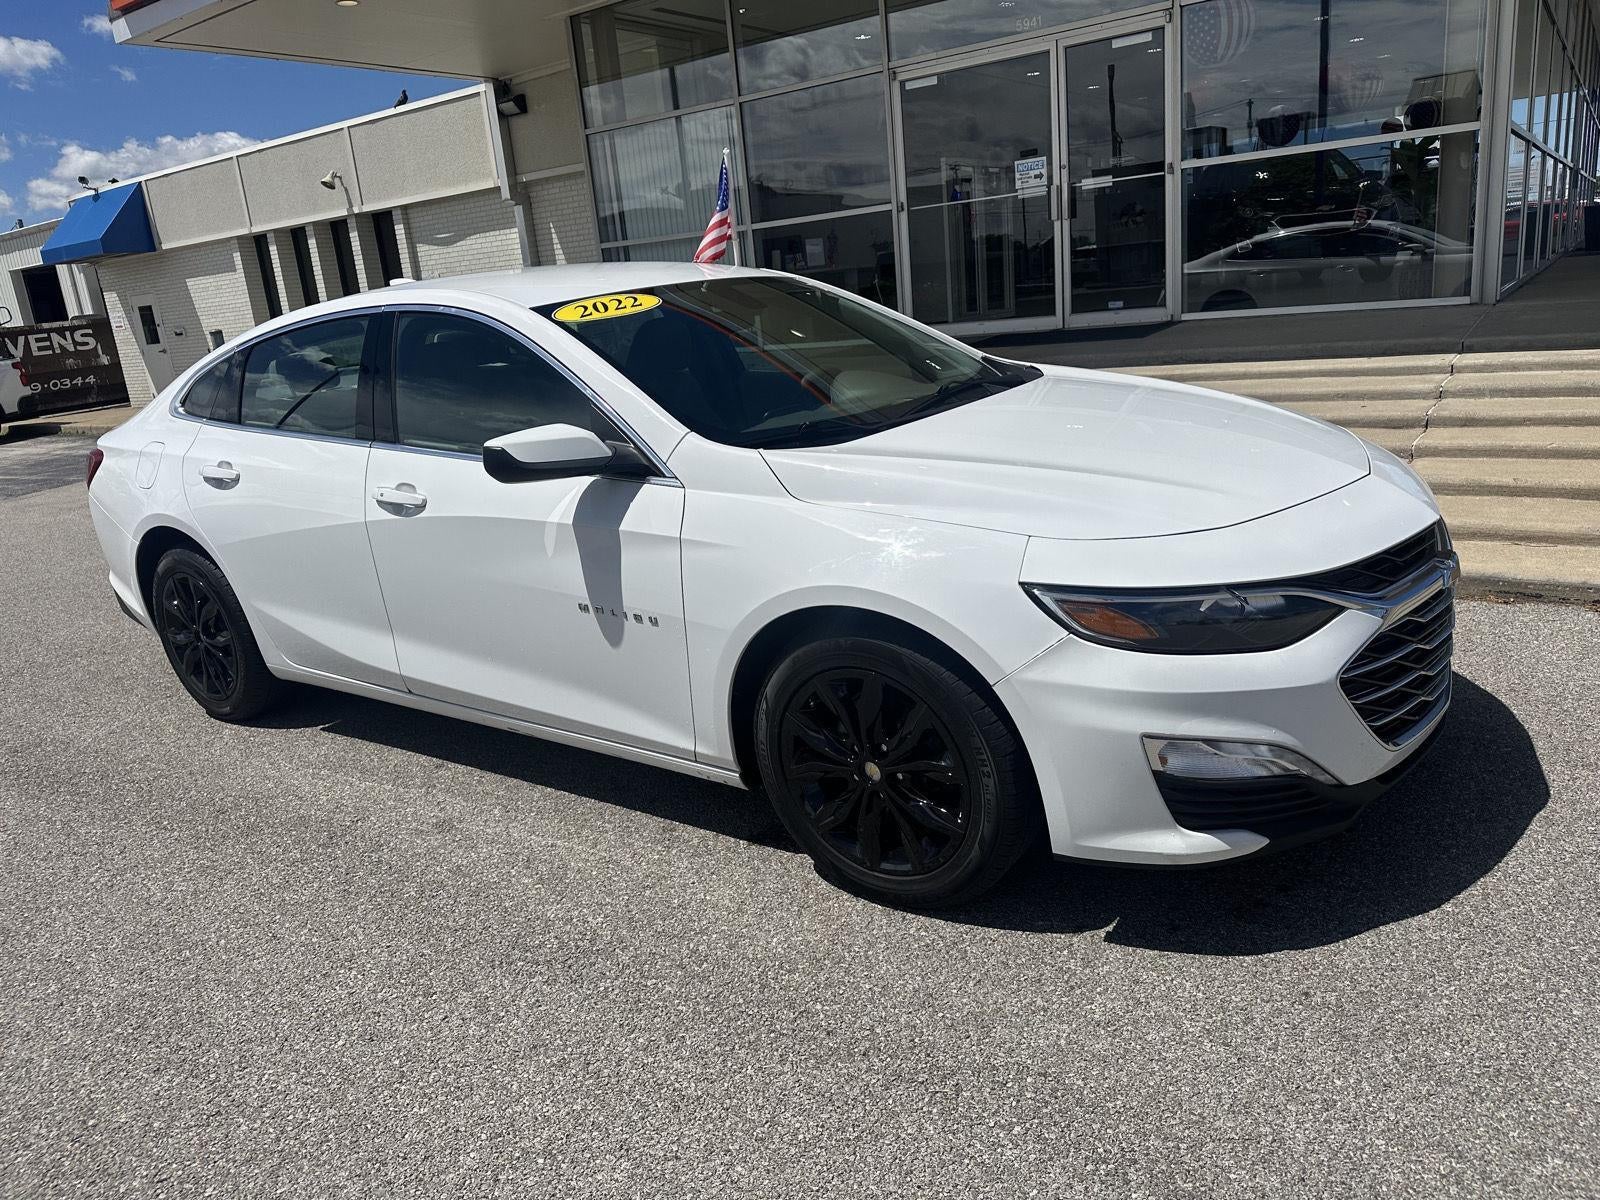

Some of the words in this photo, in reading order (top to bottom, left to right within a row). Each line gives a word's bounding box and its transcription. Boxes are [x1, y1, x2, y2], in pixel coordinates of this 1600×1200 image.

[1016, 15, 1042, 31] 5941
[1018, 161, 1043, 171] NOTICE
[575, 296, 642, 319] 2022
[5, 329, 96, 358] VENS
[578, 603, 659, 628] MALIBU
